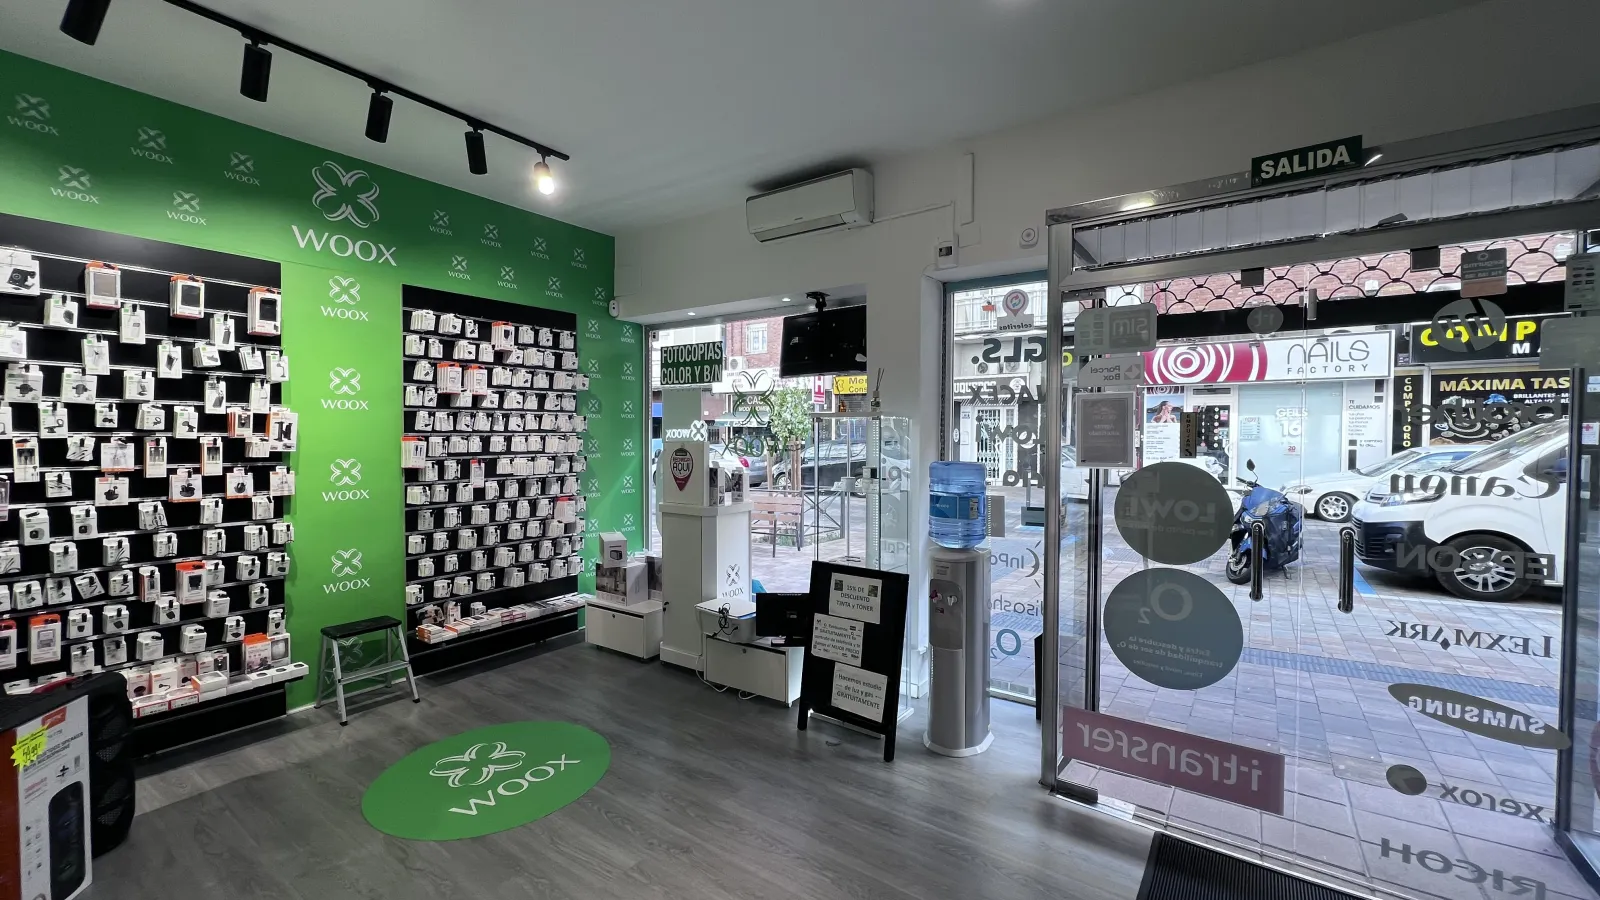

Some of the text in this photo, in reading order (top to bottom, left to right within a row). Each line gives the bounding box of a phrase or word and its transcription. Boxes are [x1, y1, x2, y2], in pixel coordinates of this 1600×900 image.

[7, 115, 59, 136] WOOX
[130, 147, 173, 165] WOOX
[1260, 145, 1350, 179] SALIDA
[224, 170, 260, 187] WOOX
[50, 187, 99, 205] WOOX
[166, 210, 207, 226] WOOX
[429, 224, 452, 236] WOOX
[291, 225, 397, 267] WOOX
[480, 238, 502, 248] WOOX
[530, 251, 549, 260] WOOX
[570, 259, 588, 269] WOOX
[448, 271, 471, 280] WOOX
[497, 281, 518, 290] WOOX
[545, 290, 564, 299] WOOX
[320, 305, 369, 321] WOOX
[661, 343, 722, 364] FOTOCOPIAS
[661, 367, 692, 384] COLOR
[694, 367, 703, 382] Y
[703, 364, 722, 382] B/N
[1286, 363, 1369, 375] FACTORY
[1439, 377, 1526, 392] MÁXIMA
[320, 398, 369, 411] WOOX
[1280, 420, 1302, 437] 16
[1402, 425, 1412, 448] ORO
[322, 489, 369, 502] WOOX
[323, 577, 370, 594] WOOX
[836, 600, 851, 608] TINTA
[840, 593, 870, 602] DESCUENTO
[838, 673, 882, 691] Hacemos estudio
[851, 686, 860, 694] luz
[836, 690, 880, 710] GRATUITAMENTE
[447, 753, 581, 816] WOOX
